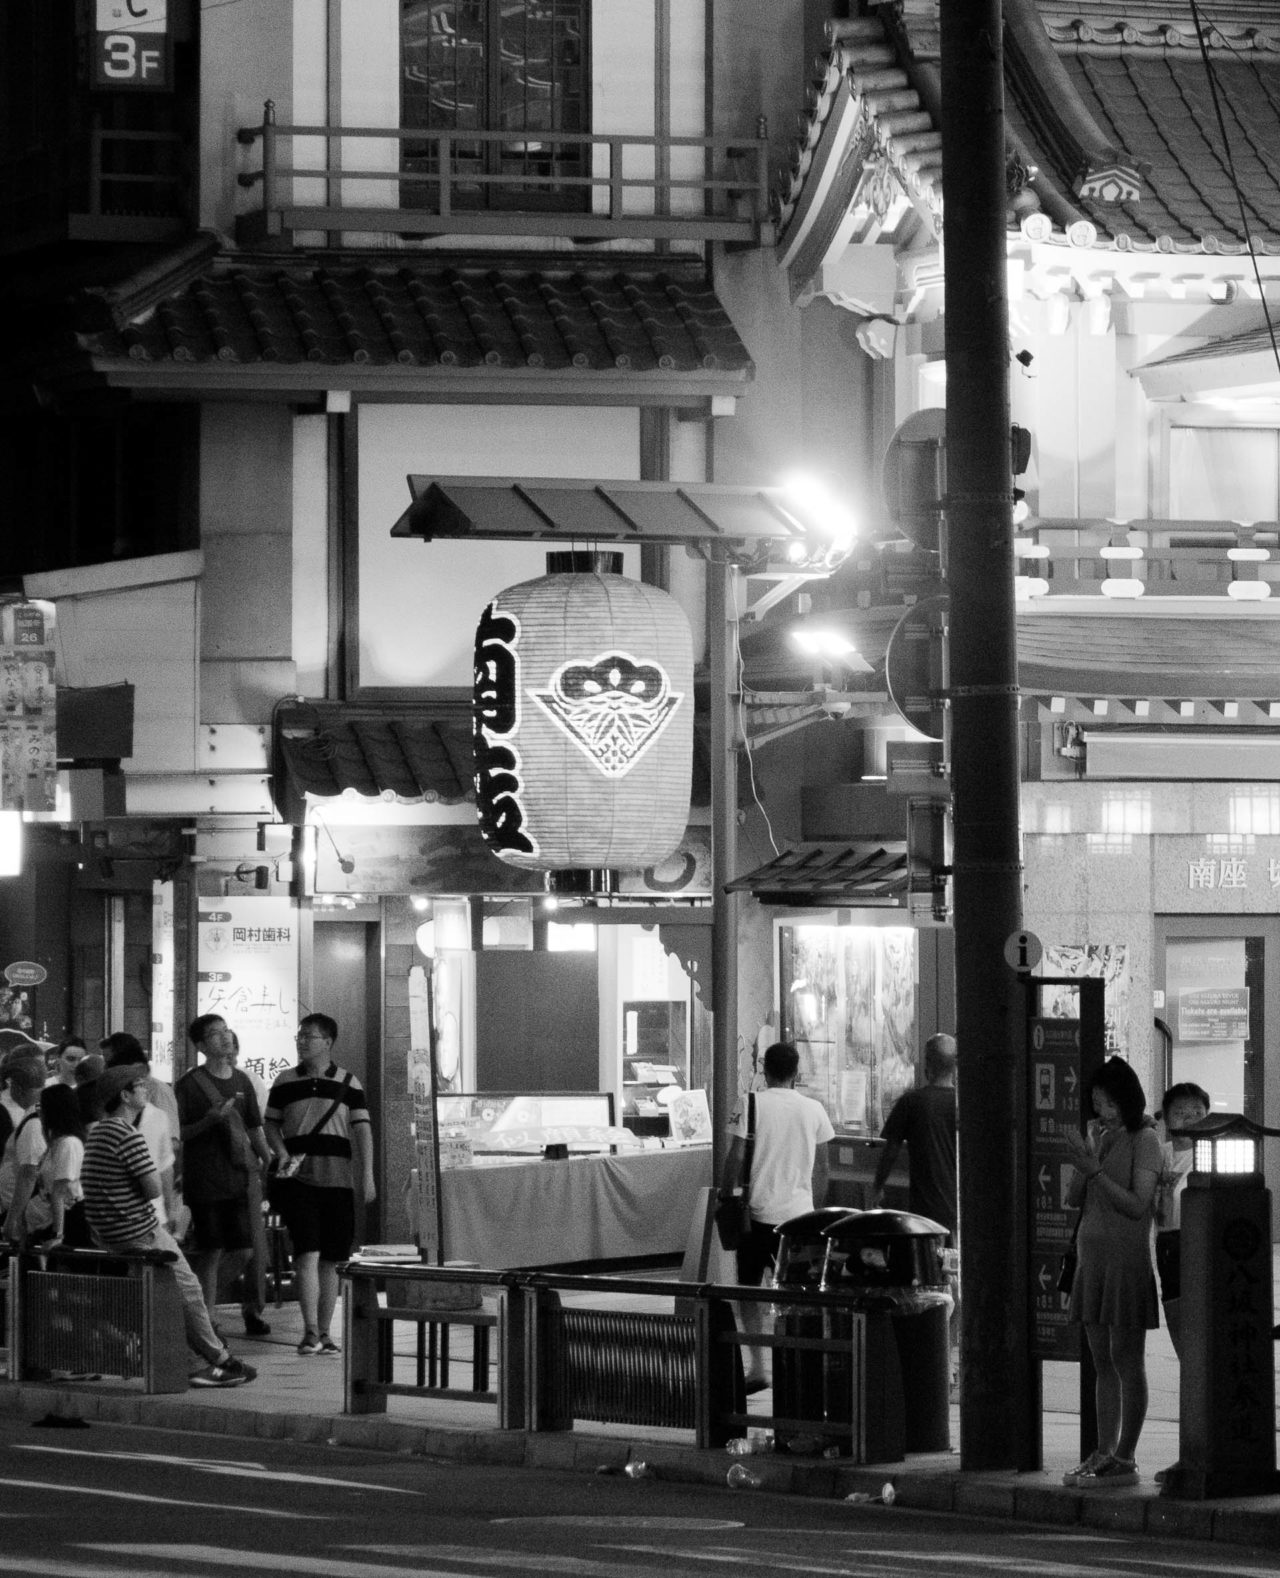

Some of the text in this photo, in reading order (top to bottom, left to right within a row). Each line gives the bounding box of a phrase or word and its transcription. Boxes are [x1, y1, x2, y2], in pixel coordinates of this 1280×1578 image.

[104, 34, 160, 78] 3F
[1187, 857, 1248, 889] 南座
[208, 913, 223, 922] 4F
[232, 926, 291, 943] 岡村歯科
[208, 973, 223, 982] 3F
